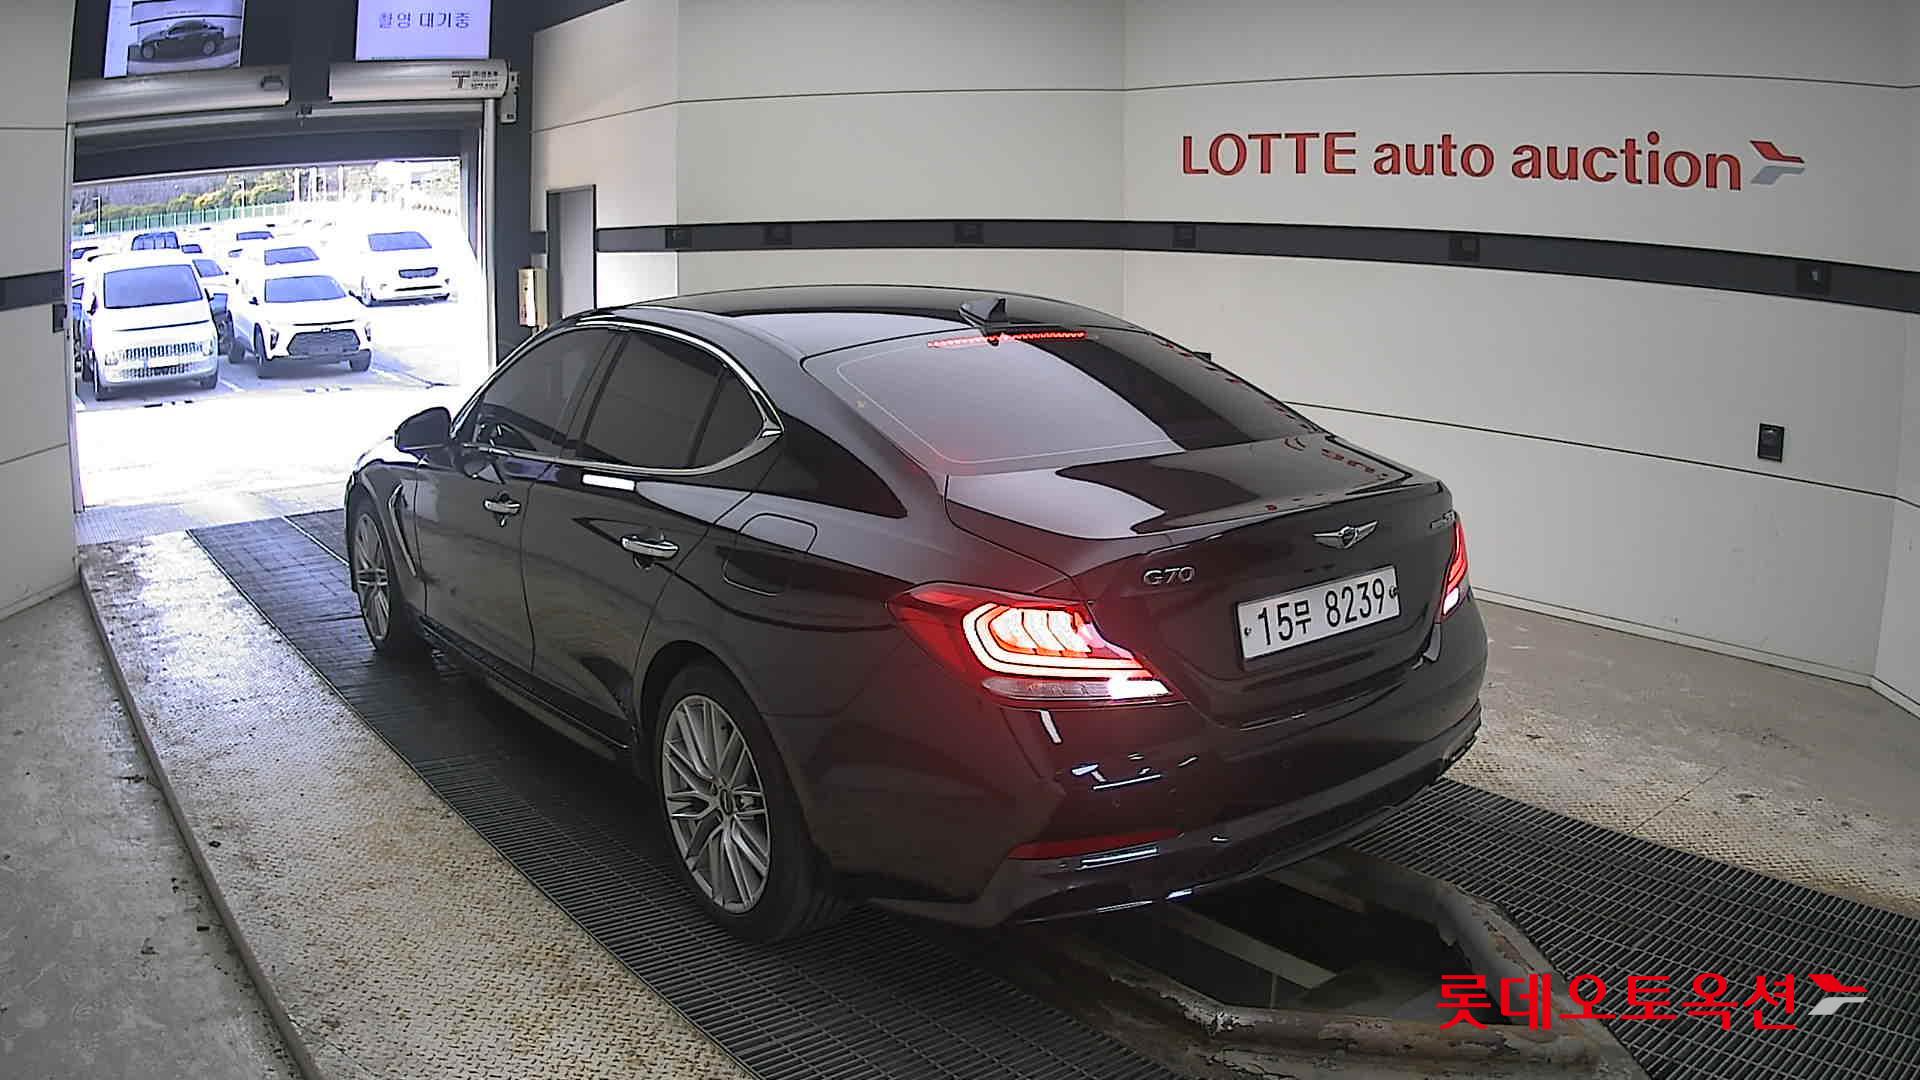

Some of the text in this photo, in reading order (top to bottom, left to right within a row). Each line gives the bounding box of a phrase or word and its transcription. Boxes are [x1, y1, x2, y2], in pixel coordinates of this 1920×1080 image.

[419, 11, 473, 29] 대기중
[1182, 131, 1742, 191] LOTTE auto auction
[1143, 566, 1195, 585] G70
[1257, 577, 1385, 646] 15무 8239
